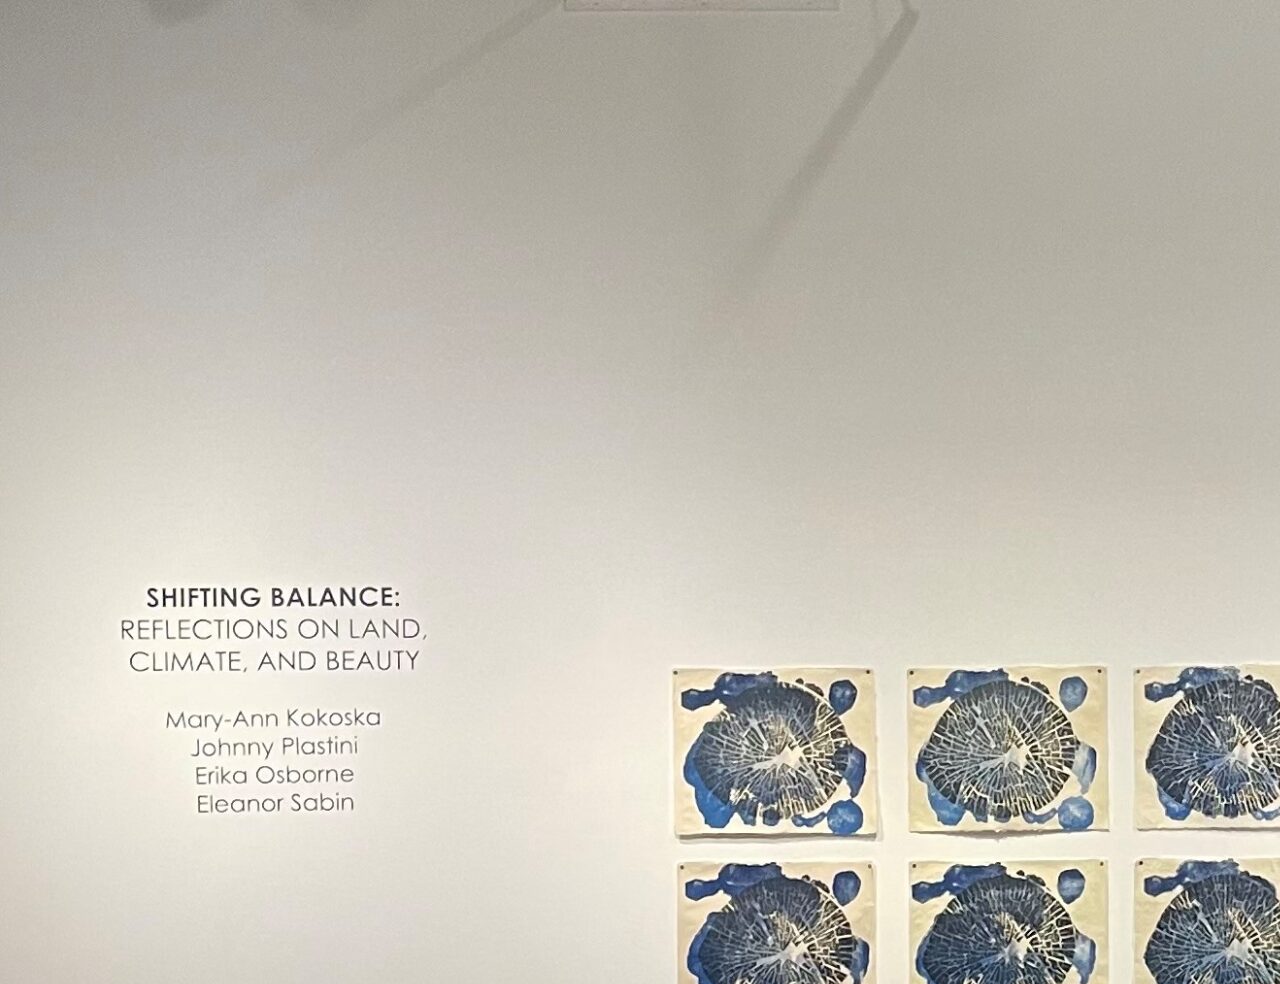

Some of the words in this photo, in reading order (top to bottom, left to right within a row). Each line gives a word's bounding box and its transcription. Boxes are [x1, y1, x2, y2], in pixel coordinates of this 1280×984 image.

[147, 587, 261, 607] SHIFTING
[272, 587, 399, 607] BALANCE:
[121, 619, 287, 640] REFLECTIONS
[298, 619, 338, 639] ON
[350, 619, 426, 640] LAND,
[130, 651, 247, 672] CLIMATE,
[258, 651, 316, 671] AND
[327, 650, 419, 671] BEAUTY
[166, 711, 278, 732] Mary-Ann
[287, 708, 380, 726] Kokoska
[191, 738, 273, 760] Johnny
[283, 736, 357, 755] Plastini
[196, 766, 247, 785] Erika
[256, 766, 354, 784] Osborne
[198, 795, 283, 813] Eleanor
[291, 792, 354, 811] Sabin
